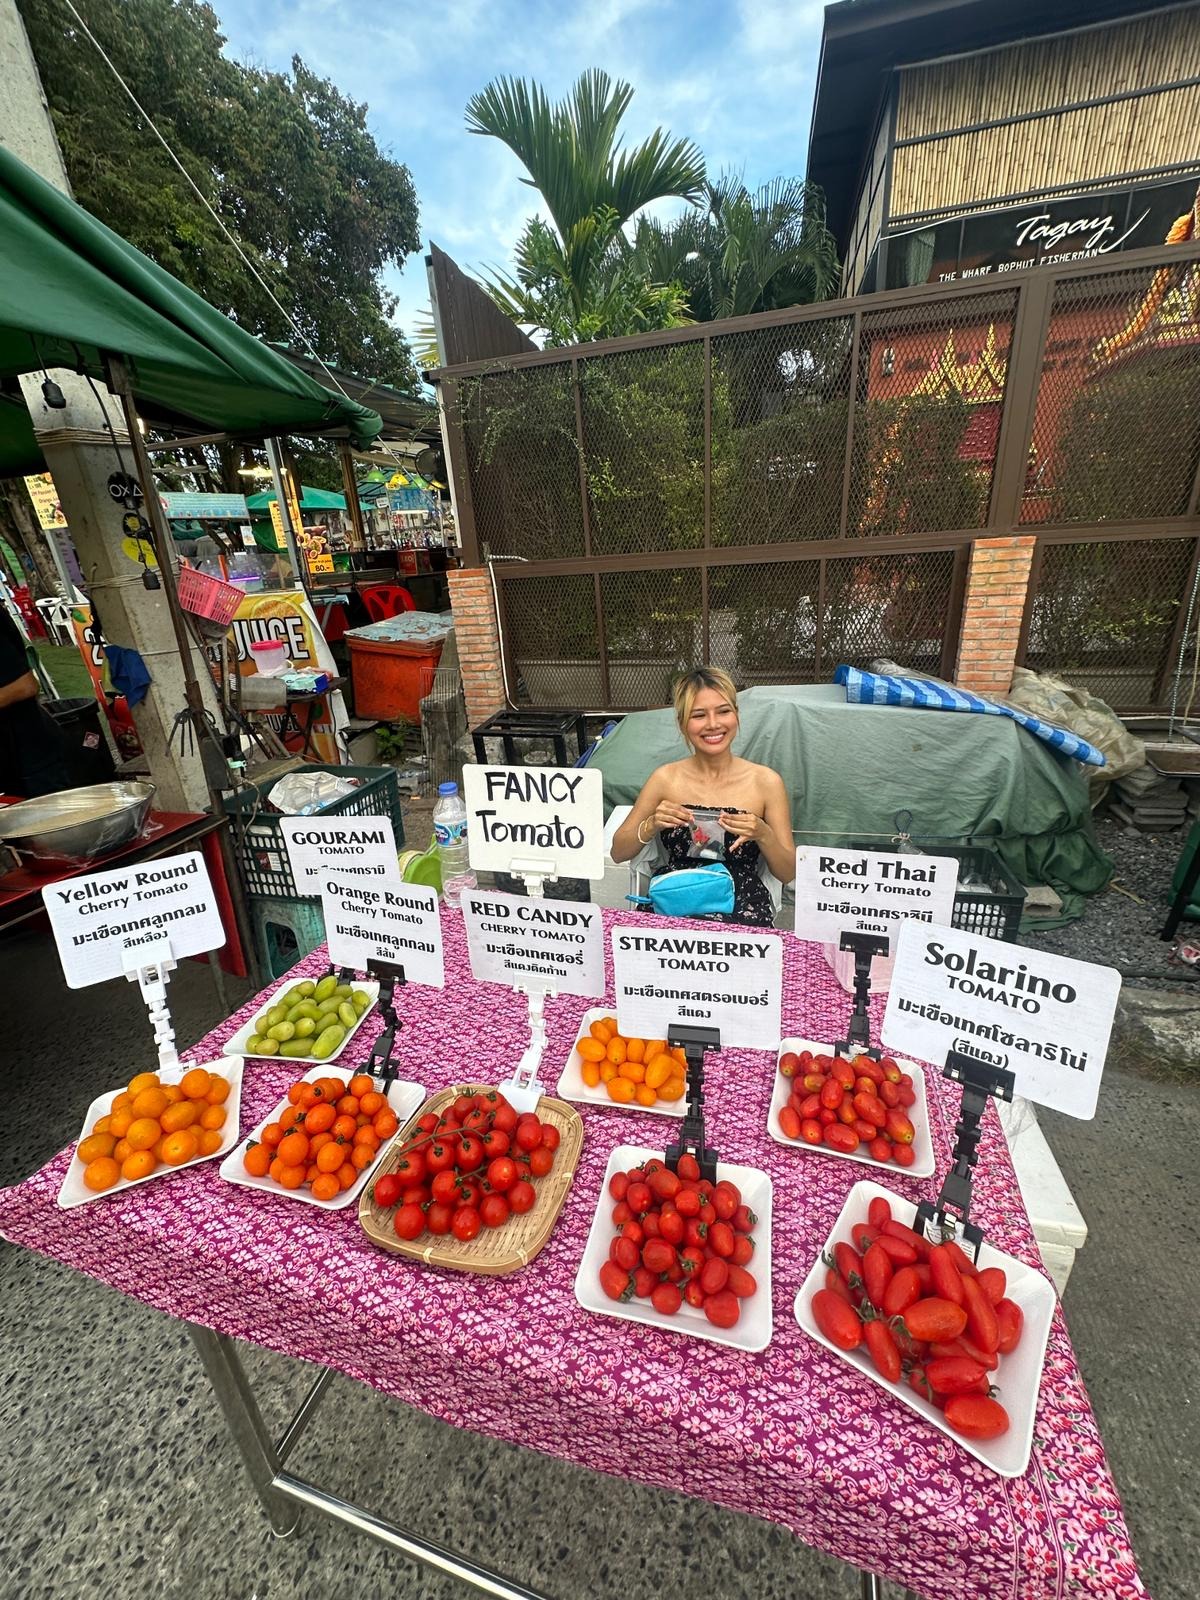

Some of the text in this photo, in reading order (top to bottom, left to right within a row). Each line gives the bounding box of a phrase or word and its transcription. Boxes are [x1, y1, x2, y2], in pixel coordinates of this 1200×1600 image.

[1016, 208, 1151, 253] Tagay
[939, 248, 1098, 282] THE WHARF BOPHUT FISHERMAN
[484, 771, 583, 804] FANCY
[292, 831, 386, 845] GOURAMI
[475, 810, 584, 849] Tomato
[319, 846, 365, 855] TOMATO
[56, 858, 199, 904] Yellow Round
[819, 856, 937, 883] Red Thai
[78, 882, 188, 915] Cherry Tomato
[326, 881, 435, 913] Orange Round
[821, 877, 932, 898] Cherry Tomato
[72, 903, 207, 946] มะเขือเทศลูกกลม
[341, 900, 423, 925] Cherry Tomato
[470, 900, 593, 928] RED CANDY
[123, 930, 168, 949] สีเหลือง
[336, 924, 435, 953] มะเขือเทศลูกกลม
[480, 922, 585, 944] CHERRY TOMATO
[856, 920, 888, 933] สีแดง
[376, 946, 395, 959] สีส้ม
[486, 943, 584, 965] มะเขือเทศเชอรี่
[619, 936, 770, 958] STRAWBERRY
[657, 957, 730, 973] TOMATO
[923, 942, 1077, 1004] Solarino
[623, 984, 769, 1006] มะเขือเทศสตรอเบอรี่
[947, 974, 1041, 1014] TOMATO
[678, 1005, 712, 1019] สีแดง
[898, 998, 1088, 1072] มะเขือเทศโซลาริโน่
